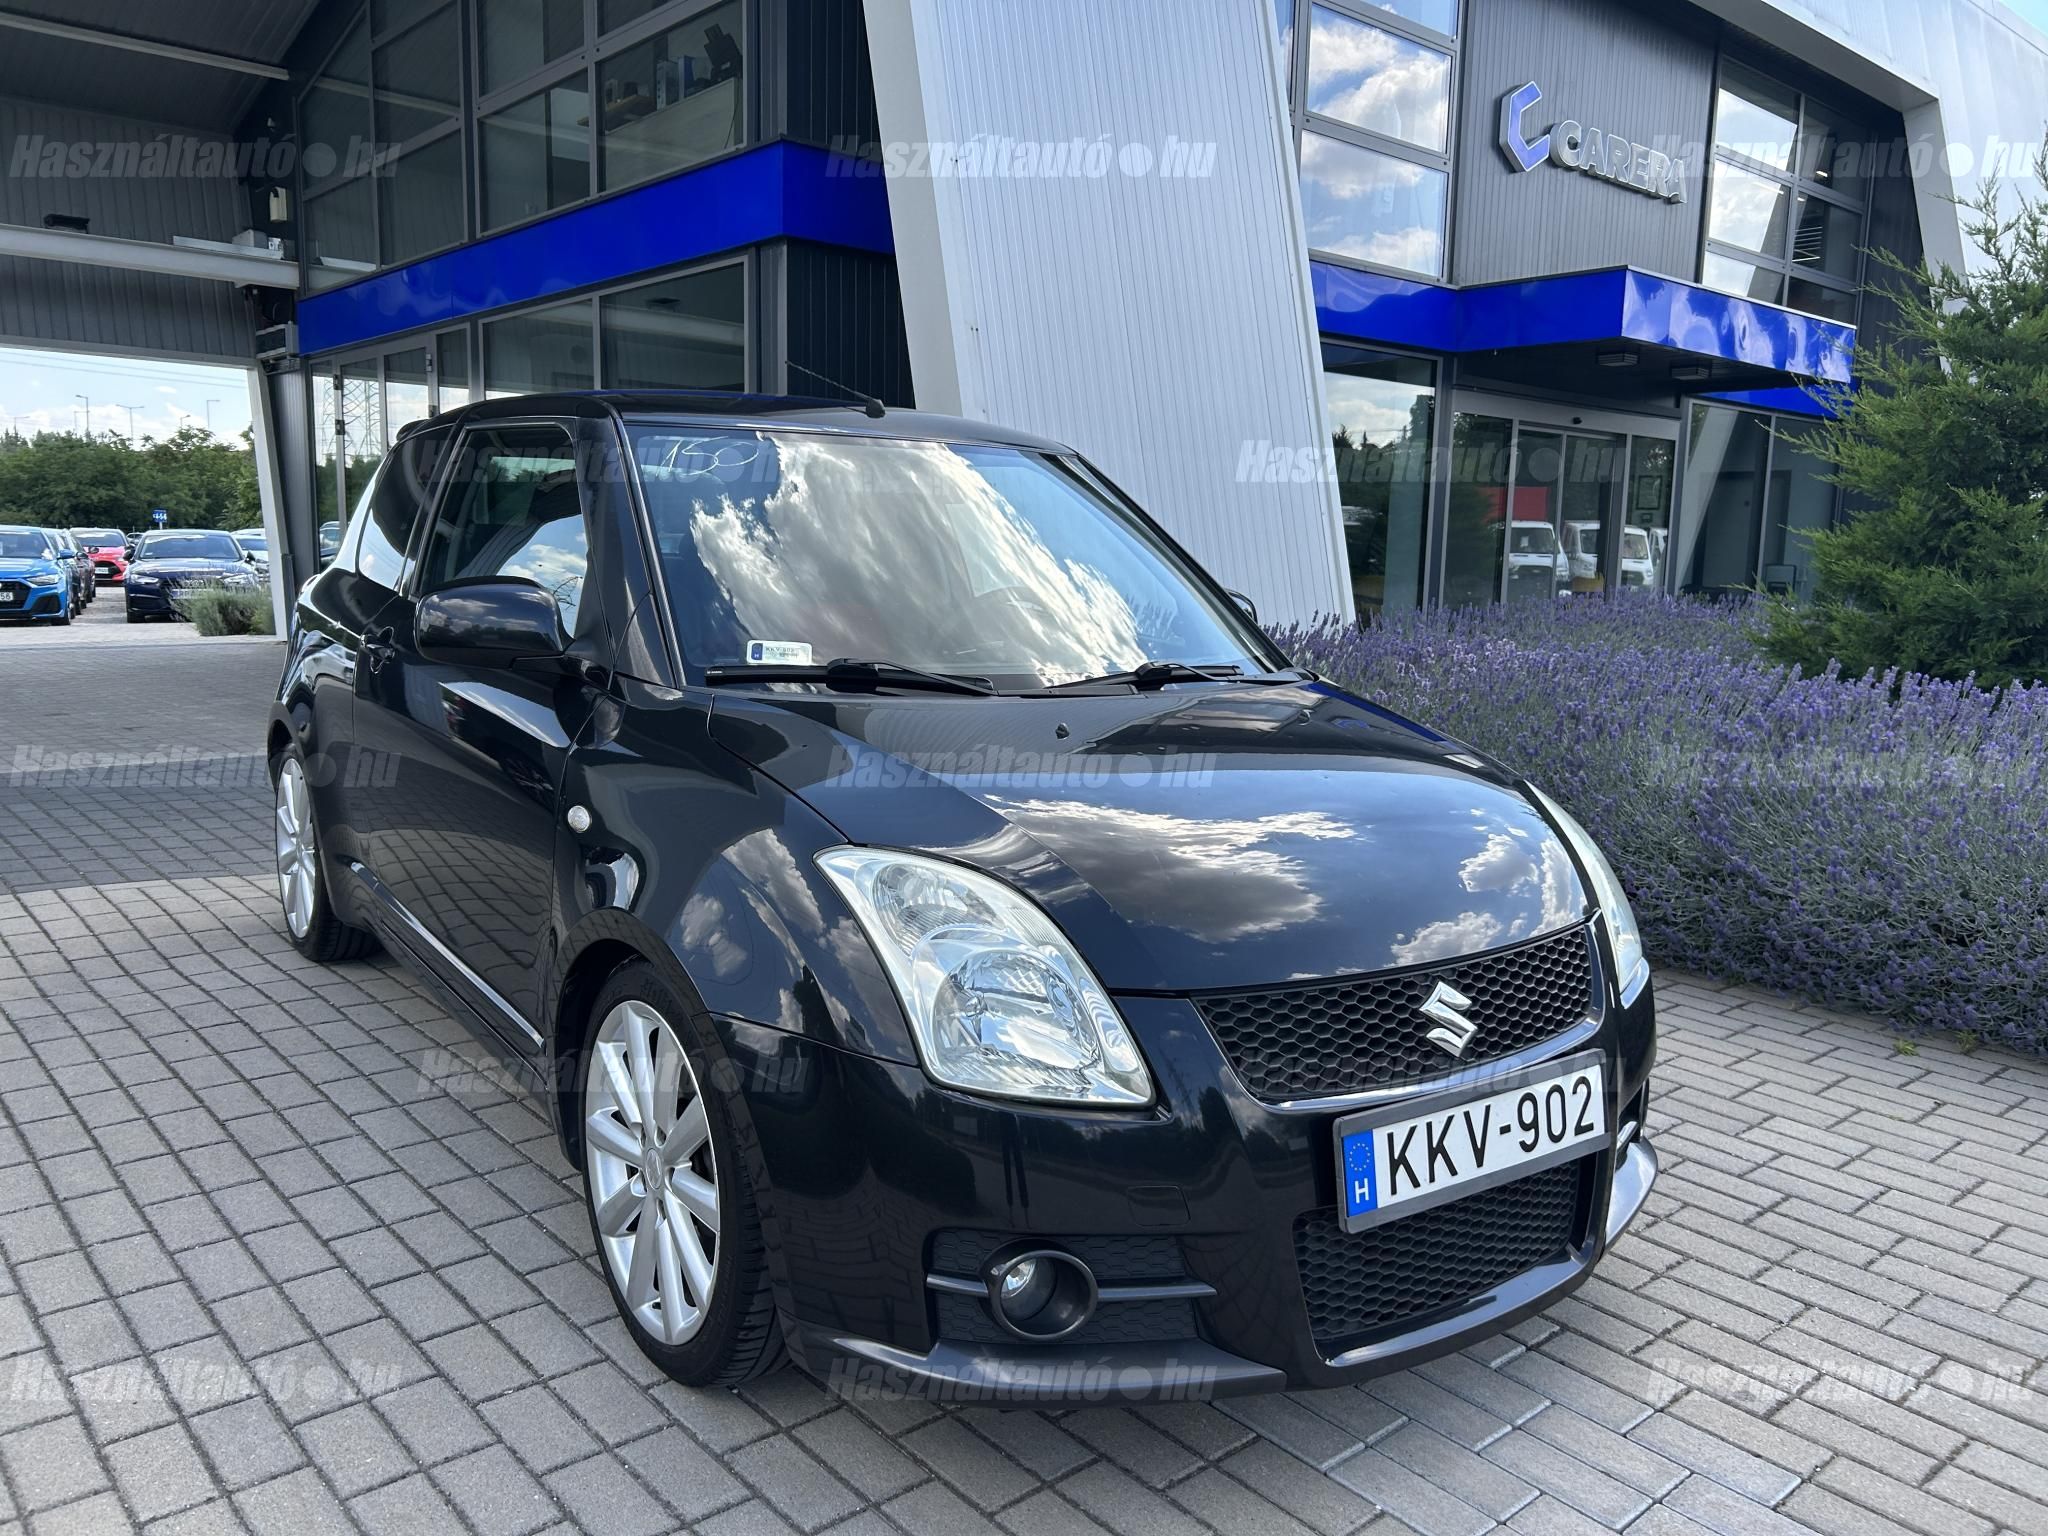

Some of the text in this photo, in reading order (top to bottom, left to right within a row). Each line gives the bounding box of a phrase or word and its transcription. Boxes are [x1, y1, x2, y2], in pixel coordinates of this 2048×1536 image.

[1551, 119, 1688, 204] CARERA
[656, 435, 759, 477] 150
[1386, 1075, 1595, 1196] KKV-902
[1354, 1177, 1370, 1204] H
